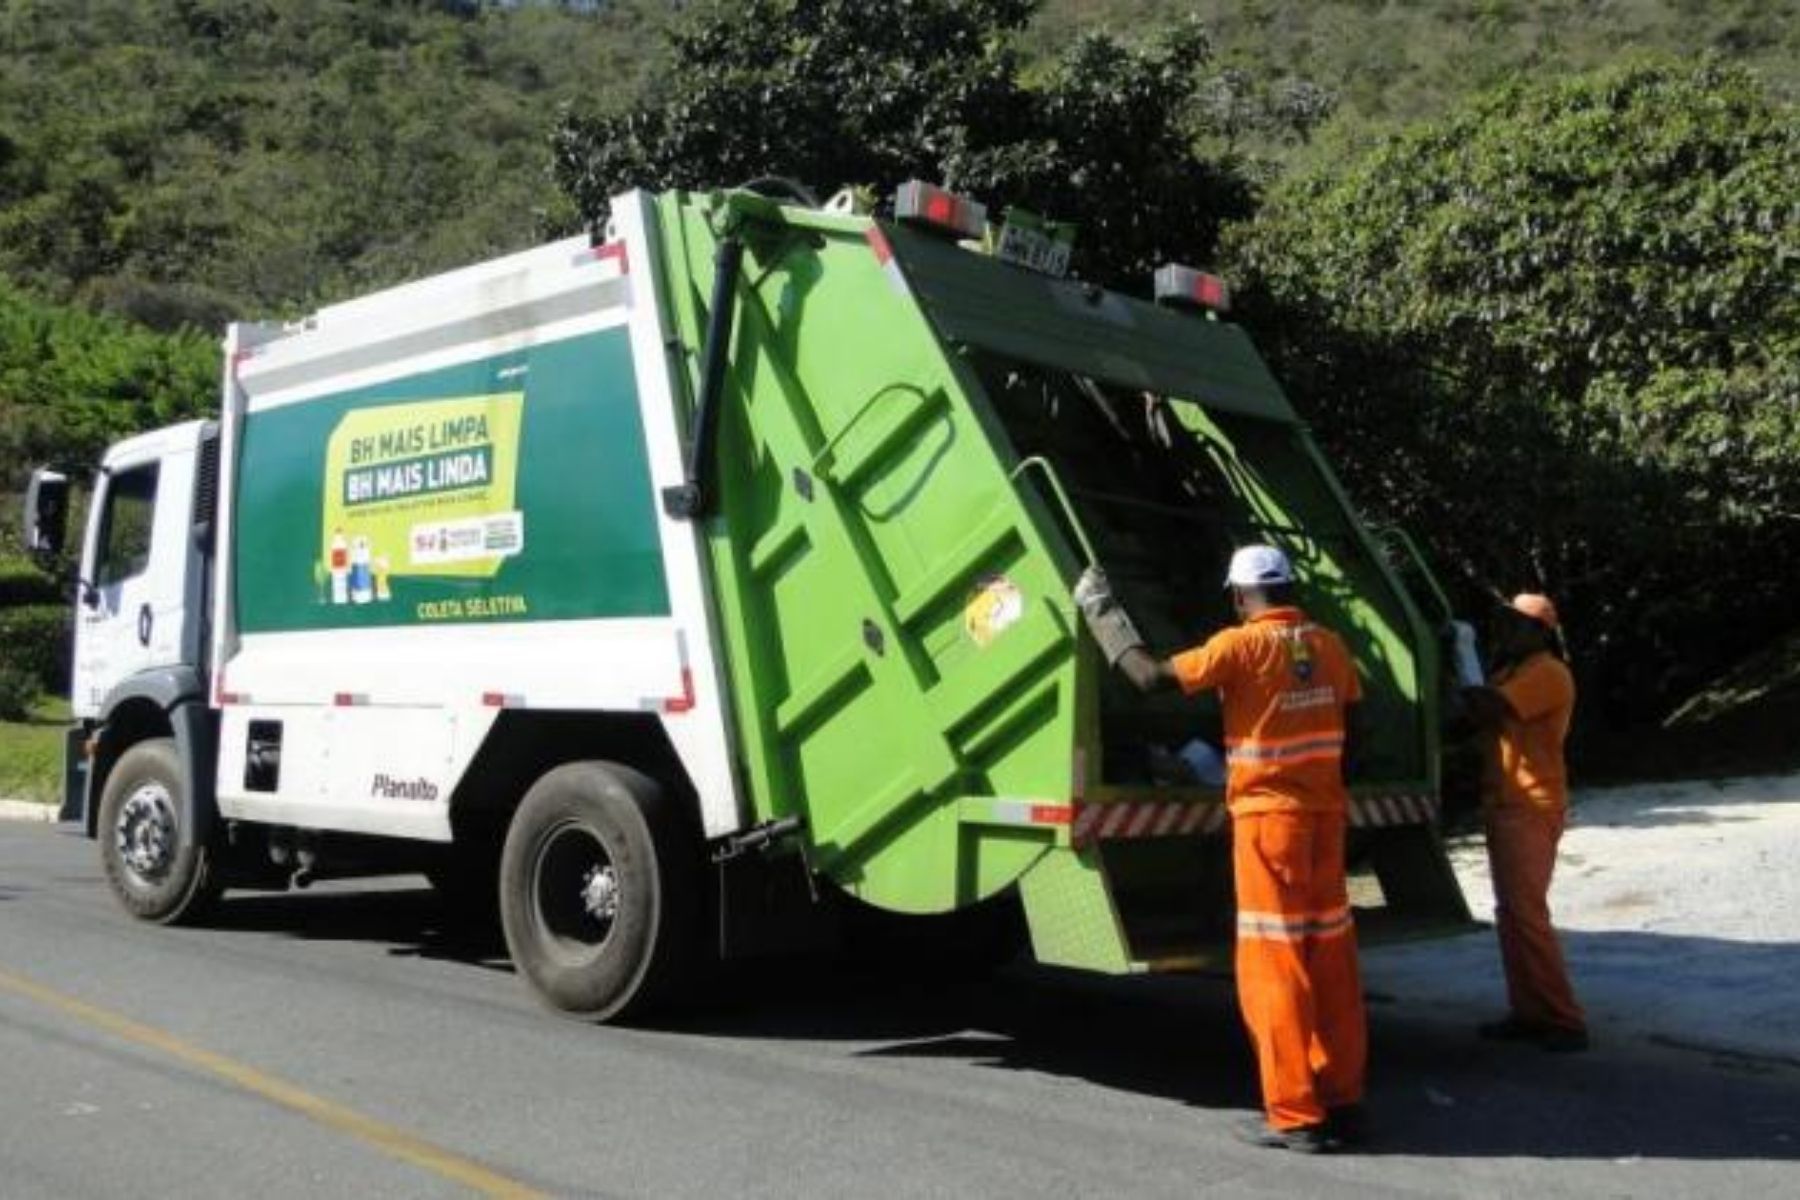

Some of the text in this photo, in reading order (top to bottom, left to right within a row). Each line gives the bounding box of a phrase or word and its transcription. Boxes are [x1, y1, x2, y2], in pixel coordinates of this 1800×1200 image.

[351, 415, 488, 463] BH MAIS LIMPA
[347, 453, 487, 499] BH MAIS LINDA
[416, 596, 526, 619] COLETA SELETIVA
[371, 774, 438, 800] Planalto
